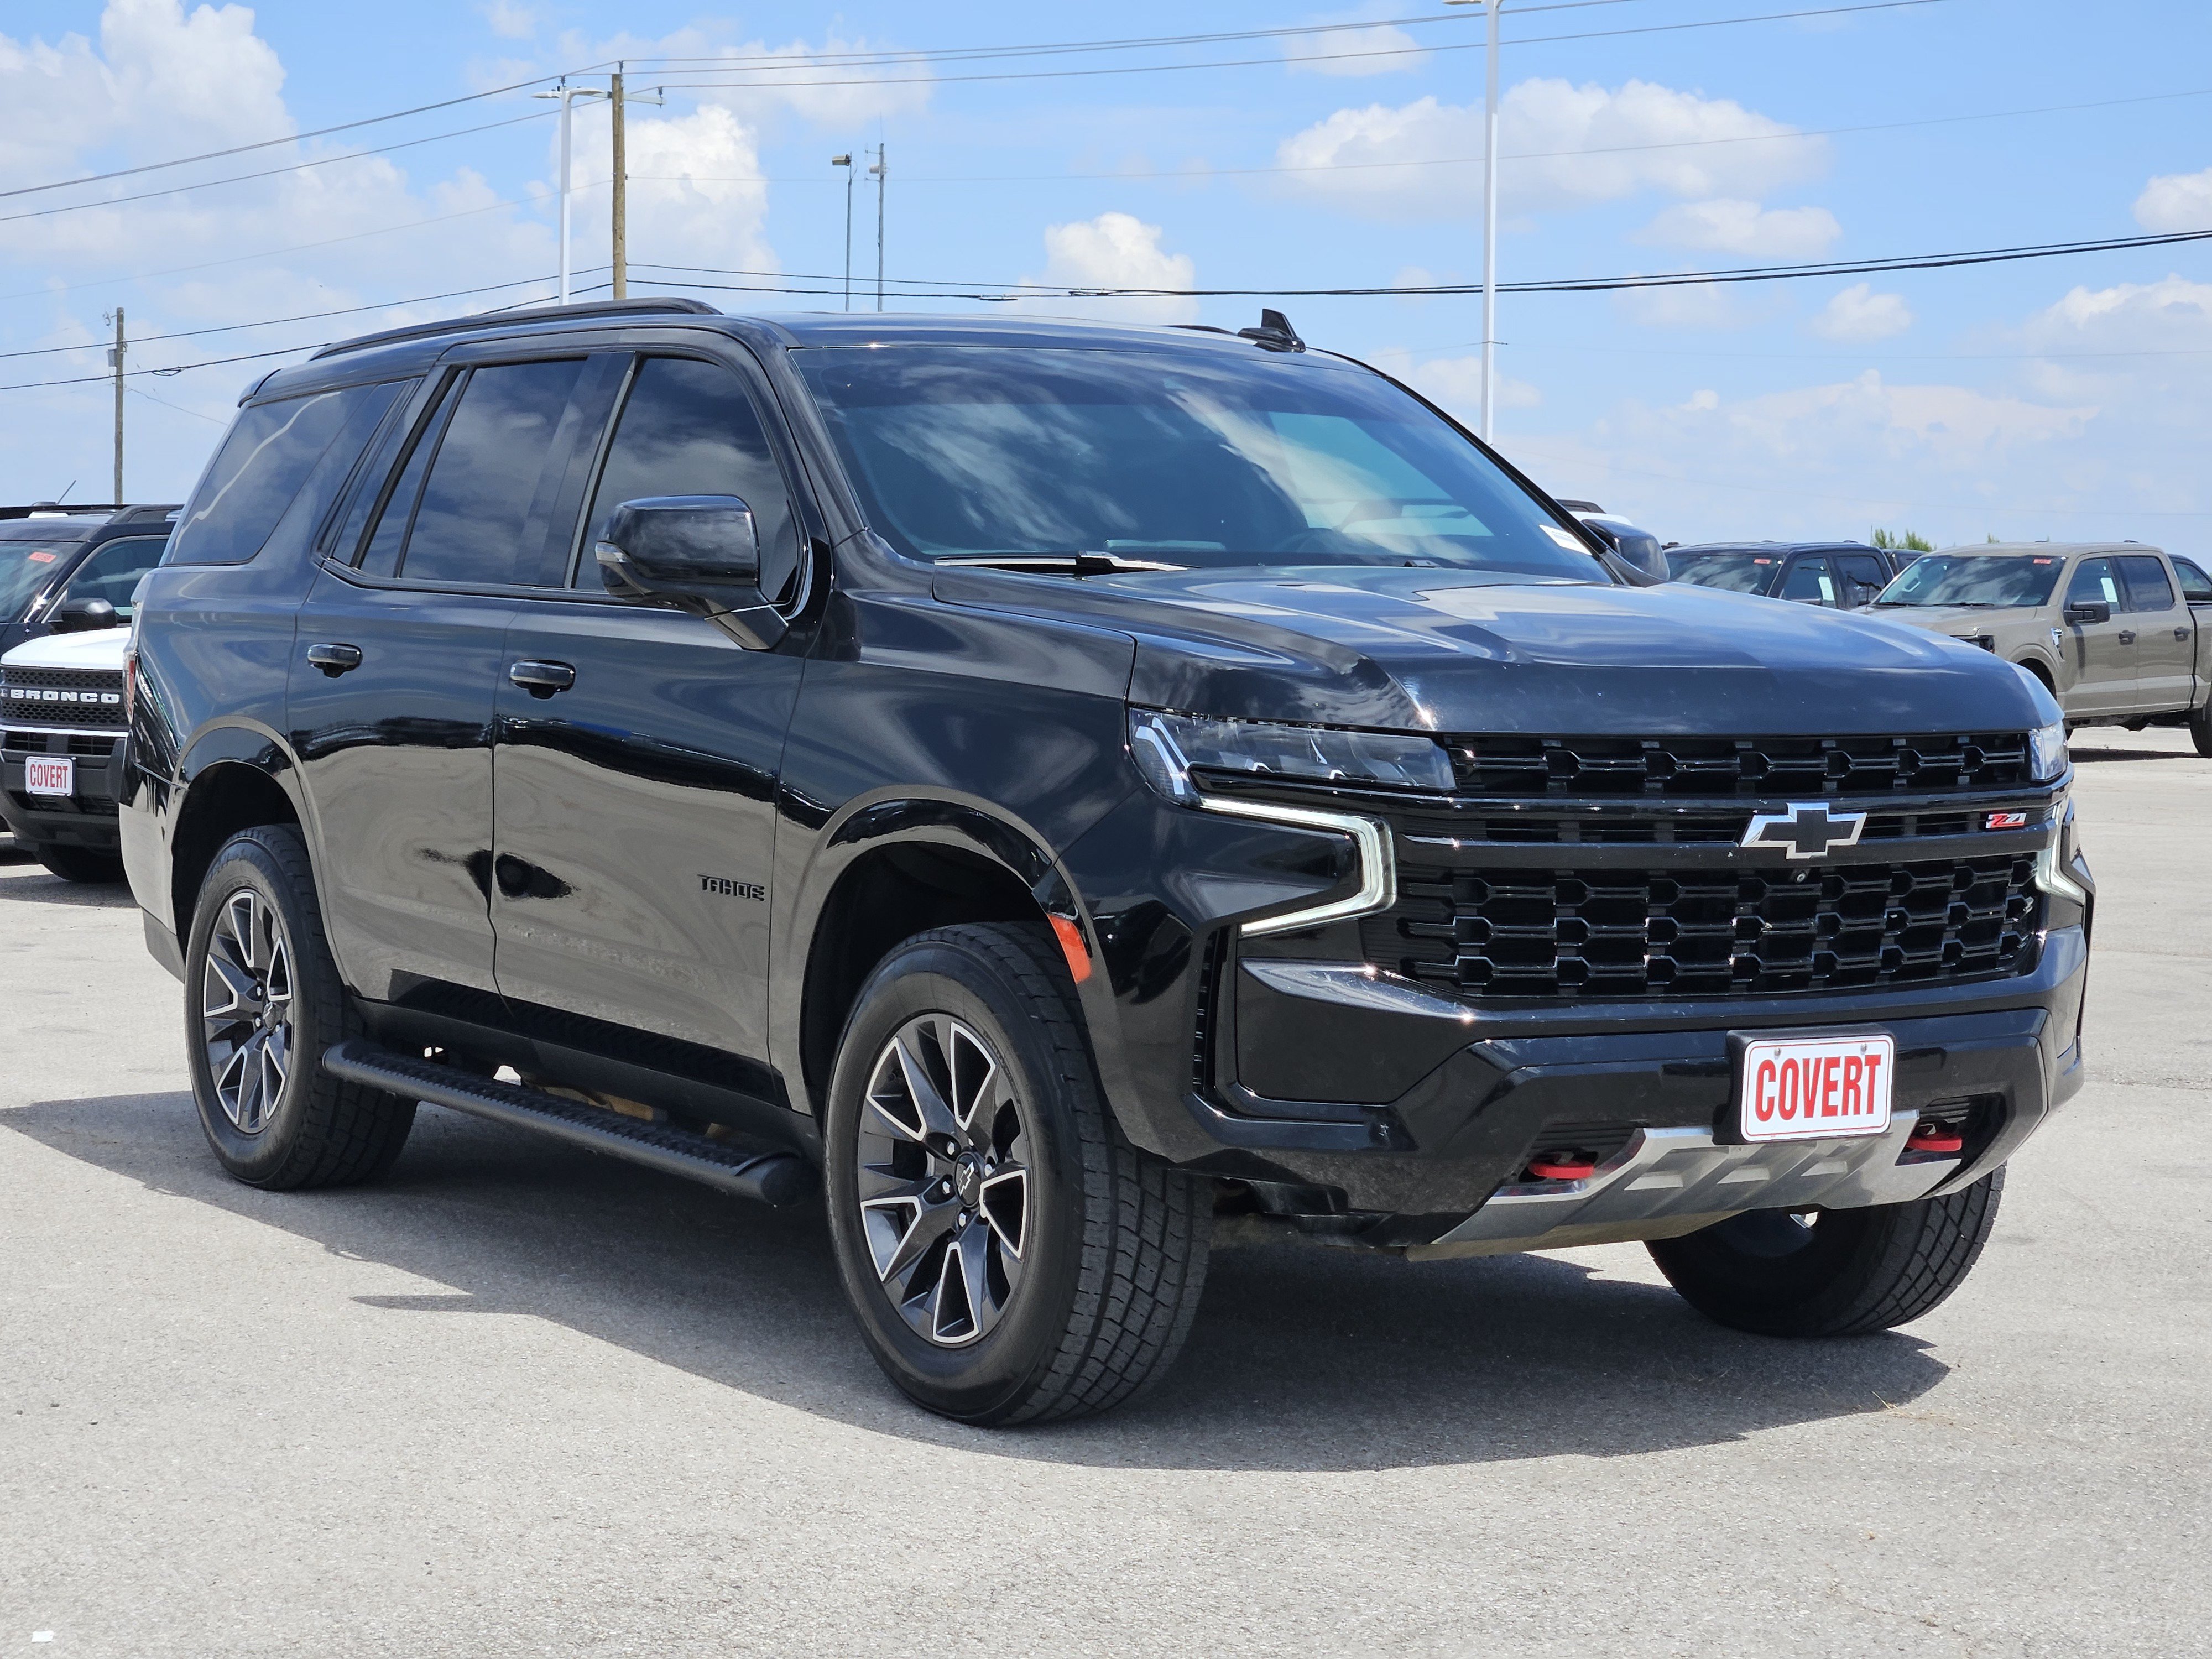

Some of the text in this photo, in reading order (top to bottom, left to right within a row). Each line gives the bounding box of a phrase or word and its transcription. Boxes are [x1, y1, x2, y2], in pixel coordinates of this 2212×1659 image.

[11, 689, 119, 703] BRONCO
[30, 764, 69, 789] COVERT
[697, 874, 765, 901] TAHOE
[1755, 1054, 1881, 1122] COVERT
